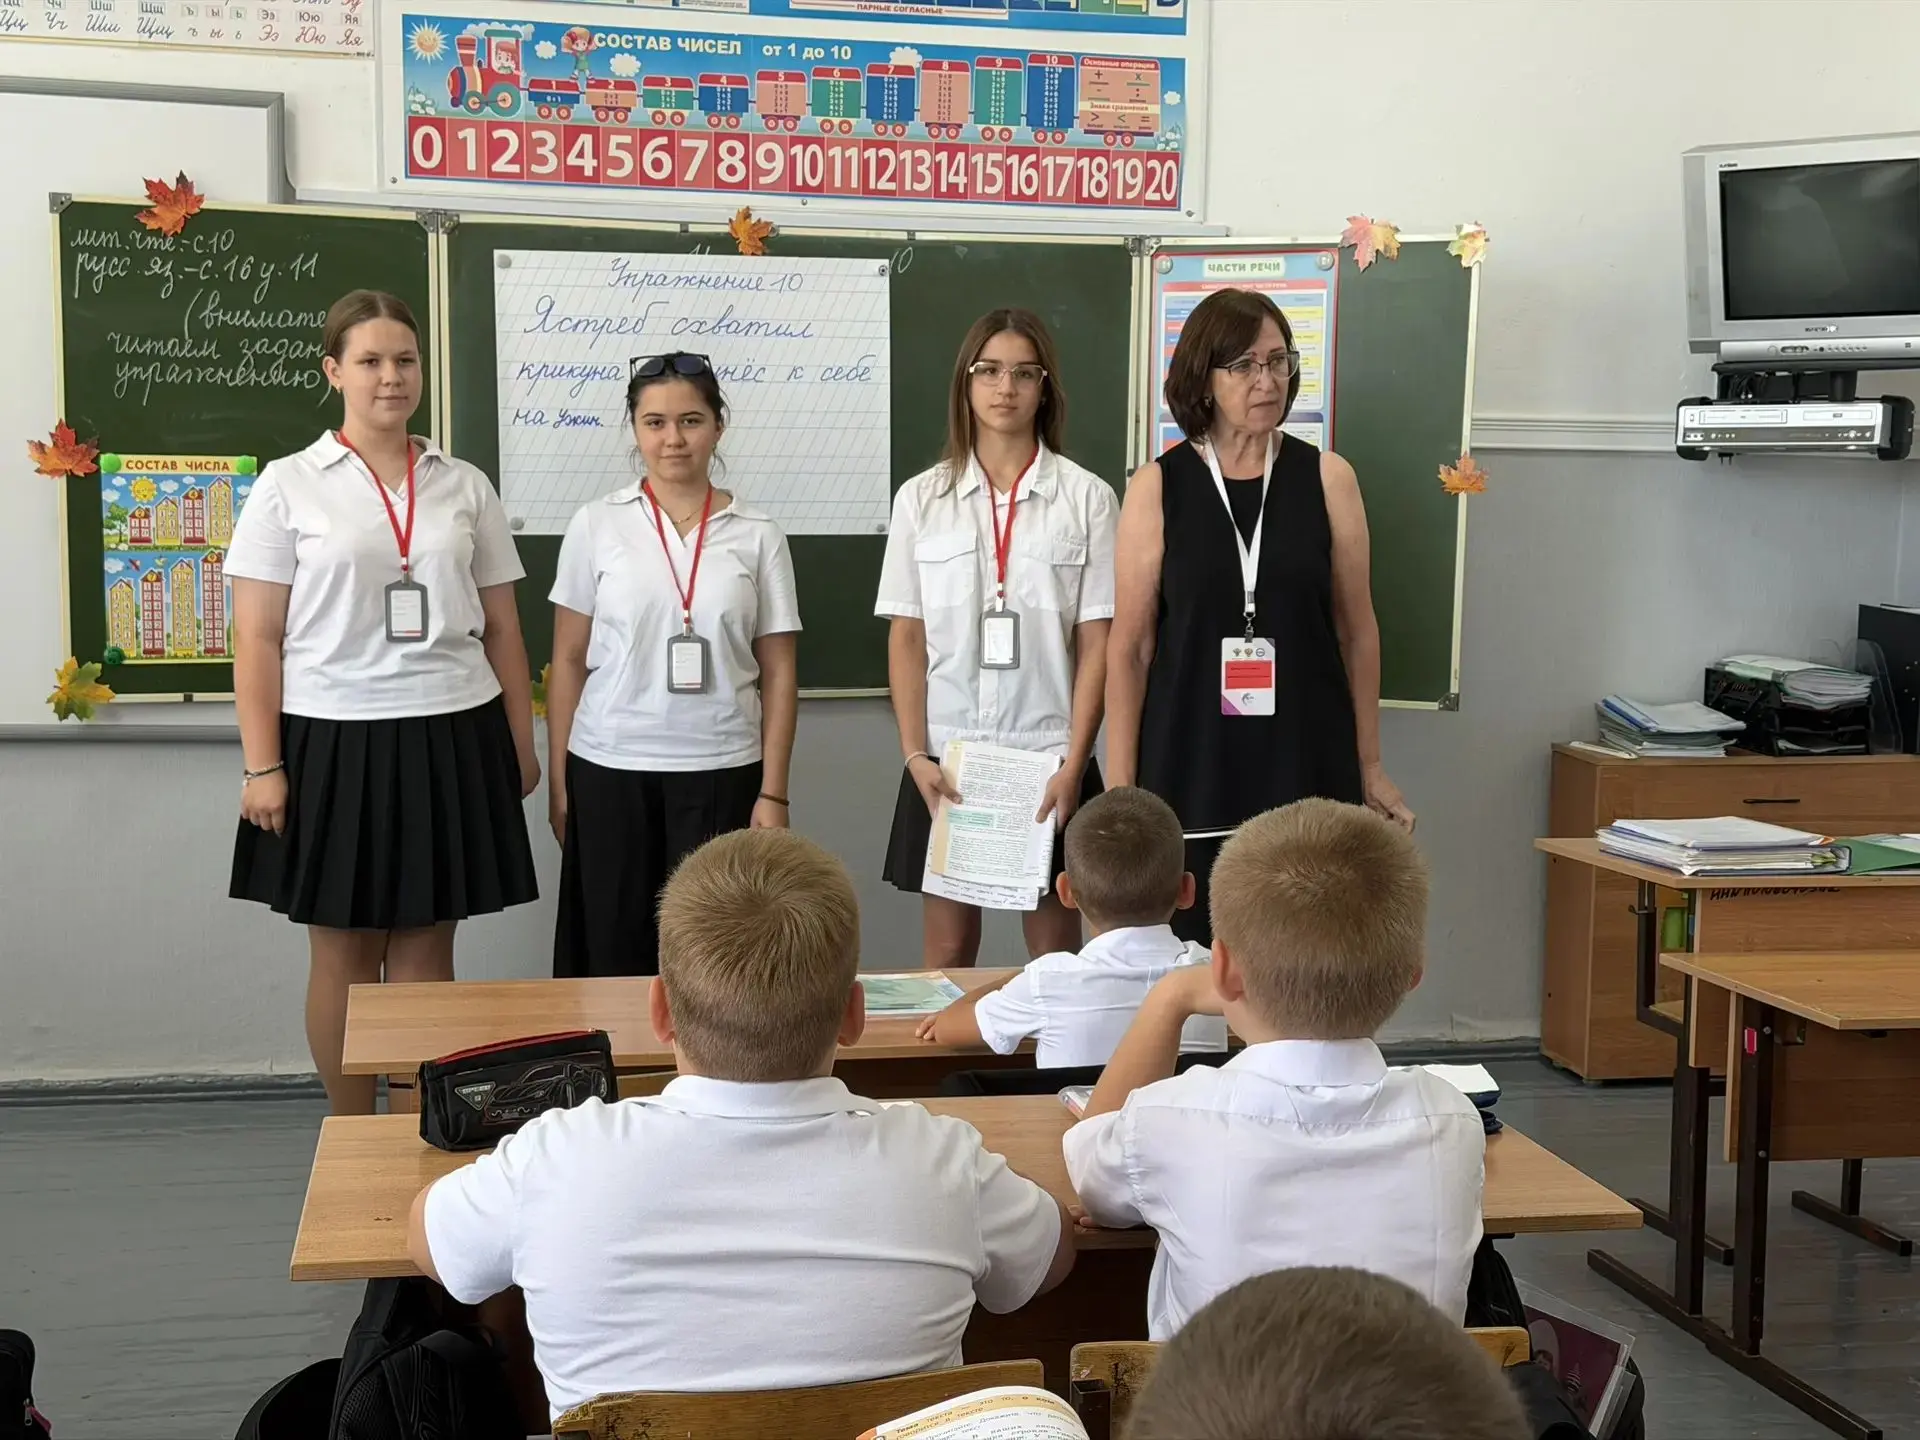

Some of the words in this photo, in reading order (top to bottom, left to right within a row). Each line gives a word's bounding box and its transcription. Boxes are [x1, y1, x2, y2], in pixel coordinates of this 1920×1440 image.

[91, 0, 112, 11] Шш
[141, 3, 164, 14] Щщ
[262, 10, 275, 20] Ээ
[300, 12, 320, 22] Юю
[344, 14, 359, 24] Яя
[856, 4, 892, 12] ПАРНЫЕ
[894, 6, 944, 14] СОГЛАСНЫЕ
[86, 14, 121, 32] Шш
[136, 17, 174, 38] Щщ
[259, 24, 280, 42] Ээ
[295, 26, 326, 44] Юю
[336, 28, 364, 46] Яя
[594, 33, 672, 50] СОСТАВ
[678, 38, 742, 55] ЧИСЕЛ
[762, 45, 782, 56] от
[788, 44, 796, 56] 1
[802, 47, 825, 60] до
[831, 46, 852, 60] 10
[996, 58, 1002, 68] 9
[1046, 56, 1058, 64] 10
[888, 65, 894, 74] 7
[942, 62, 948, 70] 8
[778, 72, 784, 81] 5
[833, 68, 840, 78] 6
[551, 80, 556, 90] 1
[608, 80, 614, 89] 2
[665, 77, 672, 87] 3
[720, 76, 727, 85] 4
[412, 126, 442, 169] 0
[458, 128, 476, 171] 1
[491, 129, 520, 173] 2
[530, 130, 558, 174] 3
[566, 134, 598, 176] 4
[606, 134, 634, 178] 5
[642, 136, 672, 180] 6
[681, 139, 708, 181] 7
[717, 140, 746, 183] 8
[756, 142, 784, 184] 9
[790, 144, 824, 186] 10
[828, 146, 858, 188] 11
[864, 148, 896, 190] 12
[900, 149, 932, 191] 13
[935, 151, 967, 193] 14
[971, 153, 1003, 194] 15
[1006, 154, 1038, 196] 16
[1042, 156, 1074, 196] 17
[1077, 156, 1108, 198] 18
[1112, 158, 1144, 200] 19
[1145, 160, 1178, 201] 20
[1208, 264, 1246, 272] ЧАСТИ
[1250, 262, 1280, 272] РЕЧИ
[608, 257, 766, 302] Упражнение
[771, 273, 804, 294] 10
[523, 295, 670, 350] Ястреб
[671, 304, 814, 339] схватил
[516, 362, 624, 398] крикуна
[787, 366, 804, 382] к
[820, 354, 876, 382] себе
[512, 408, 549, 425] на
[126, 460, 178, 470] СОСТАВ
[185, 460, 230, 471] ЧИСЛА
[896, 1423, 919, 1434] Тема
[927, 1412, 952, 1422] текста
